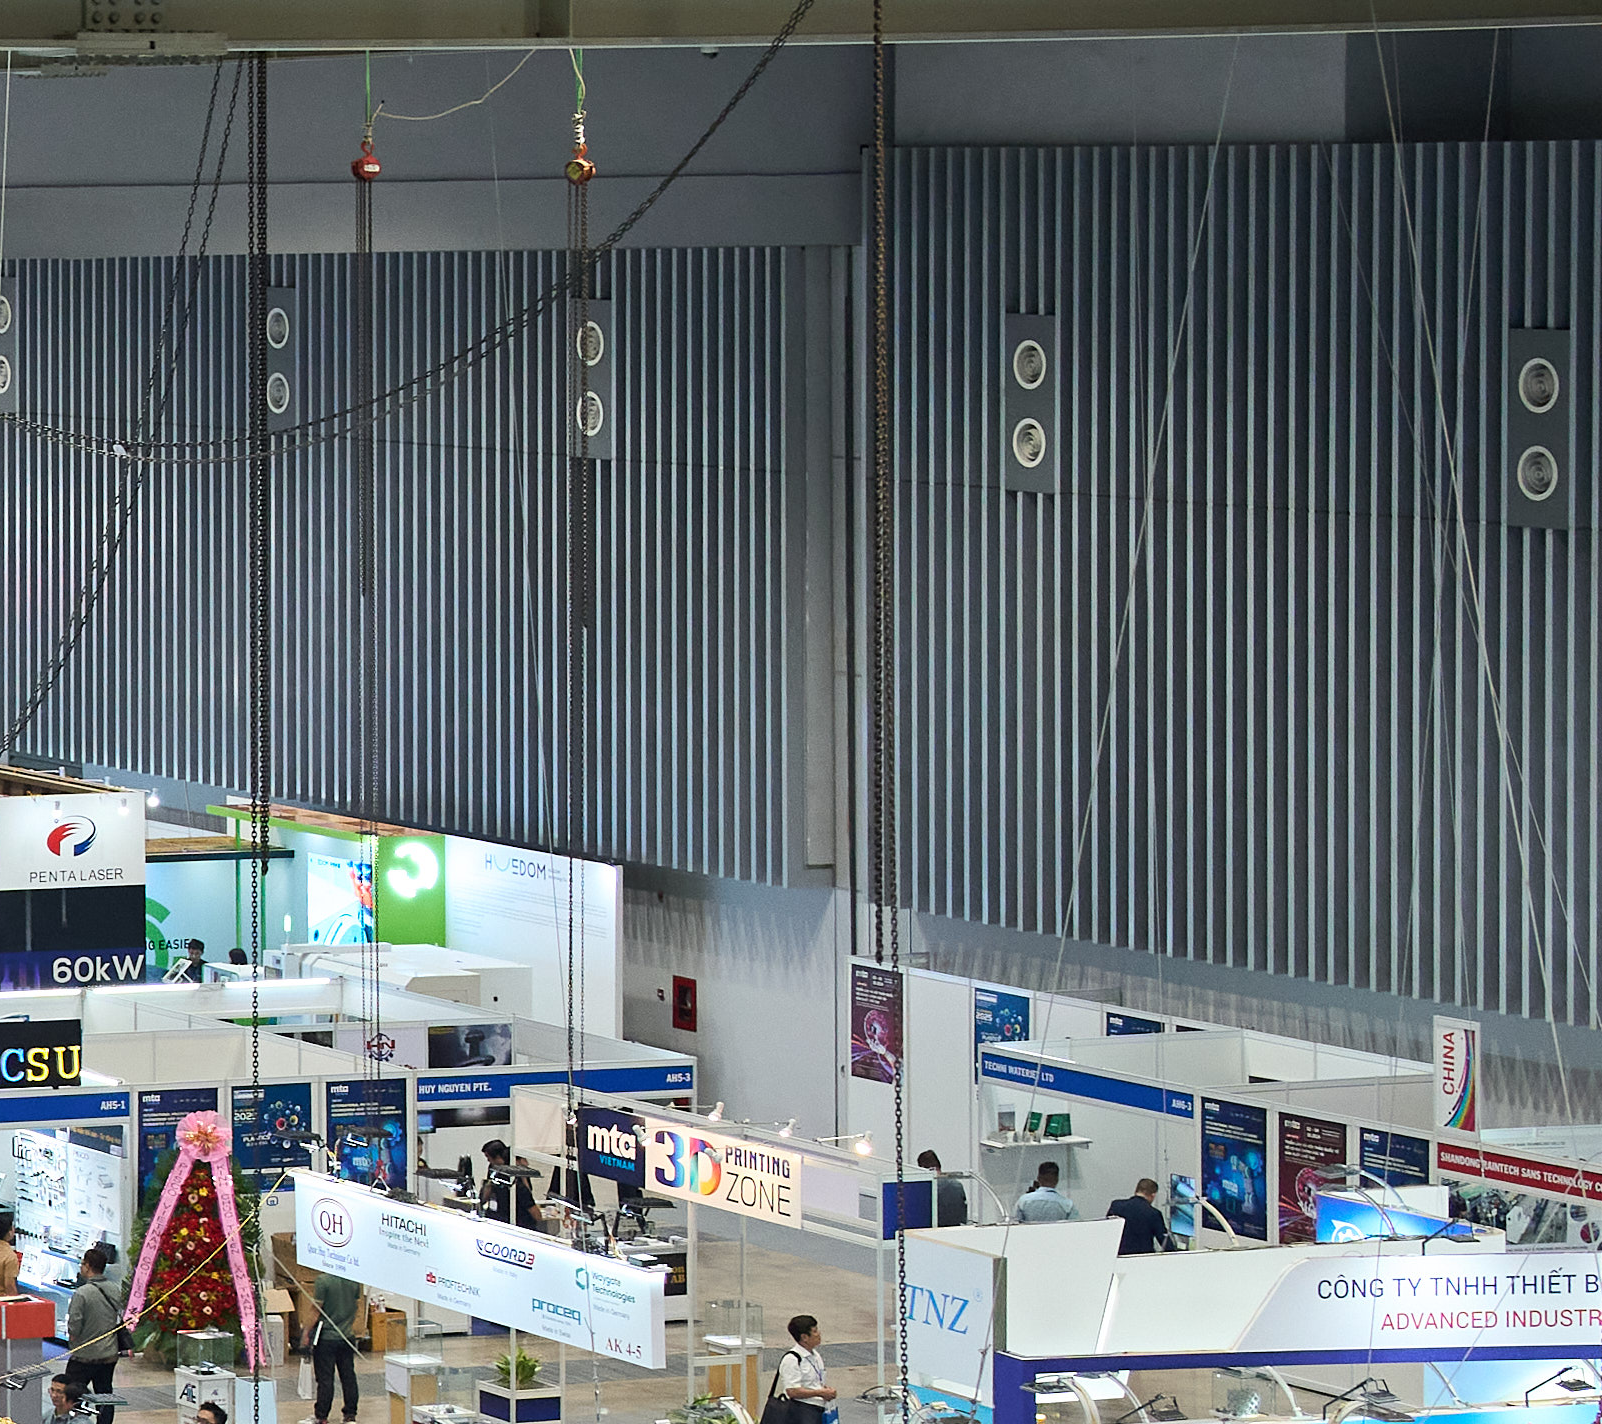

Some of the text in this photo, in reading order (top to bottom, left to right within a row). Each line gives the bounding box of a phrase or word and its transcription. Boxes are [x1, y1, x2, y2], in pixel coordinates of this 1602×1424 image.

[29, 867, 124, 883] PENTA LASER
[52, 953, 144, 984] 60kW
[1042, 1070, 1055, 1084] LTD
[1441, 1031, 1456, 1096] CHINA
[418, 1081, 493, 1096] HUY NGUYEN PTE.
[665, 1072, 691, 1085] AH5-3
[100, 1100, 127, 1112] AH5-1
[586, 1123, 637, 1161] mta
[599, 1154, 636, 1172] VIETNAM
[654, 1130, 722, 1197] 3D
[726, 1146, 791, 1179] PRINTING
[1440, 1151, 1594, 1191] SHANDONG SANS TECHNOLOGY
[726, 1170, 791, 1218] ZONE
[319, 1209, 343, 1237] QH
[380, 1212, 427, 1238] HITACHI
[483, 1241, 536, 1267] COORD3
[1317, 1266, 1577, 1300] CÔNG TY TNHH THIẾT
[532, 1298, 581, 1326] proceq
[903, 1283, 970, 1335] TNZ
[1381, 1308, 1602, 1331] ADVANCED INDUSTR
[605, 1337, 642, 1361] AK 4-5
